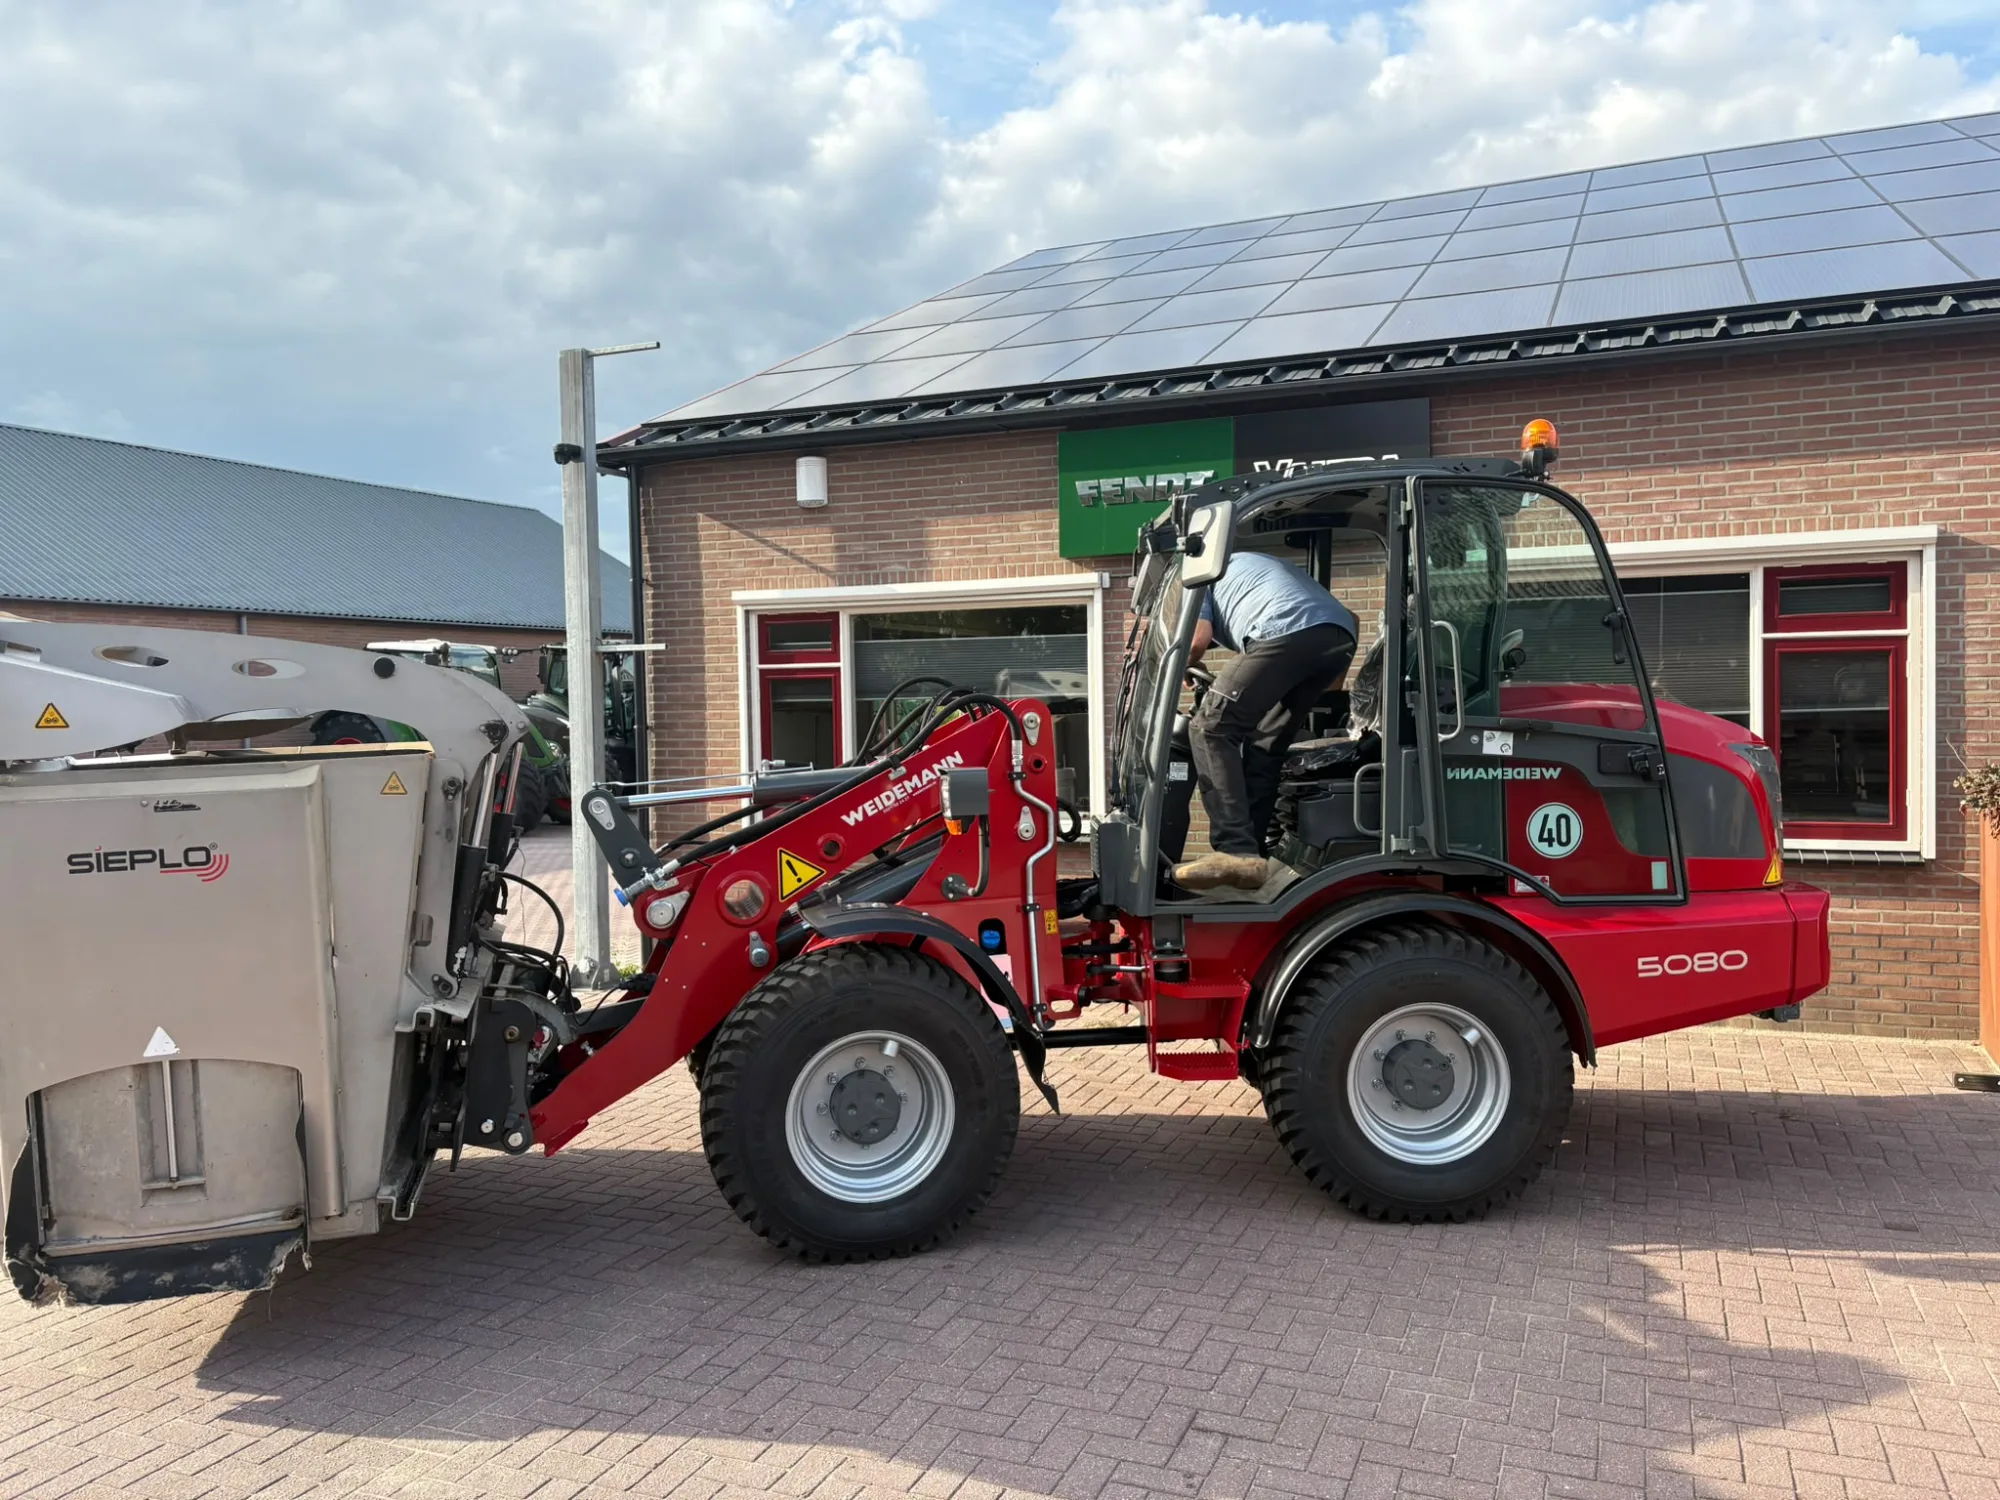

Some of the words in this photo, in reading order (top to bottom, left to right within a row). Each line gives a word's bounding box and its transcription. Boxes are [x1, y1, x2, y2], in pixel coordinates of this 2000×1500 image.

[1075, 470, 1214, 507] FENDT
[840, 751, 964, 827] WEIDEMANN
[1538, 813, 1571, 847] 40
[1637, 949, 1748, 978] 5080
